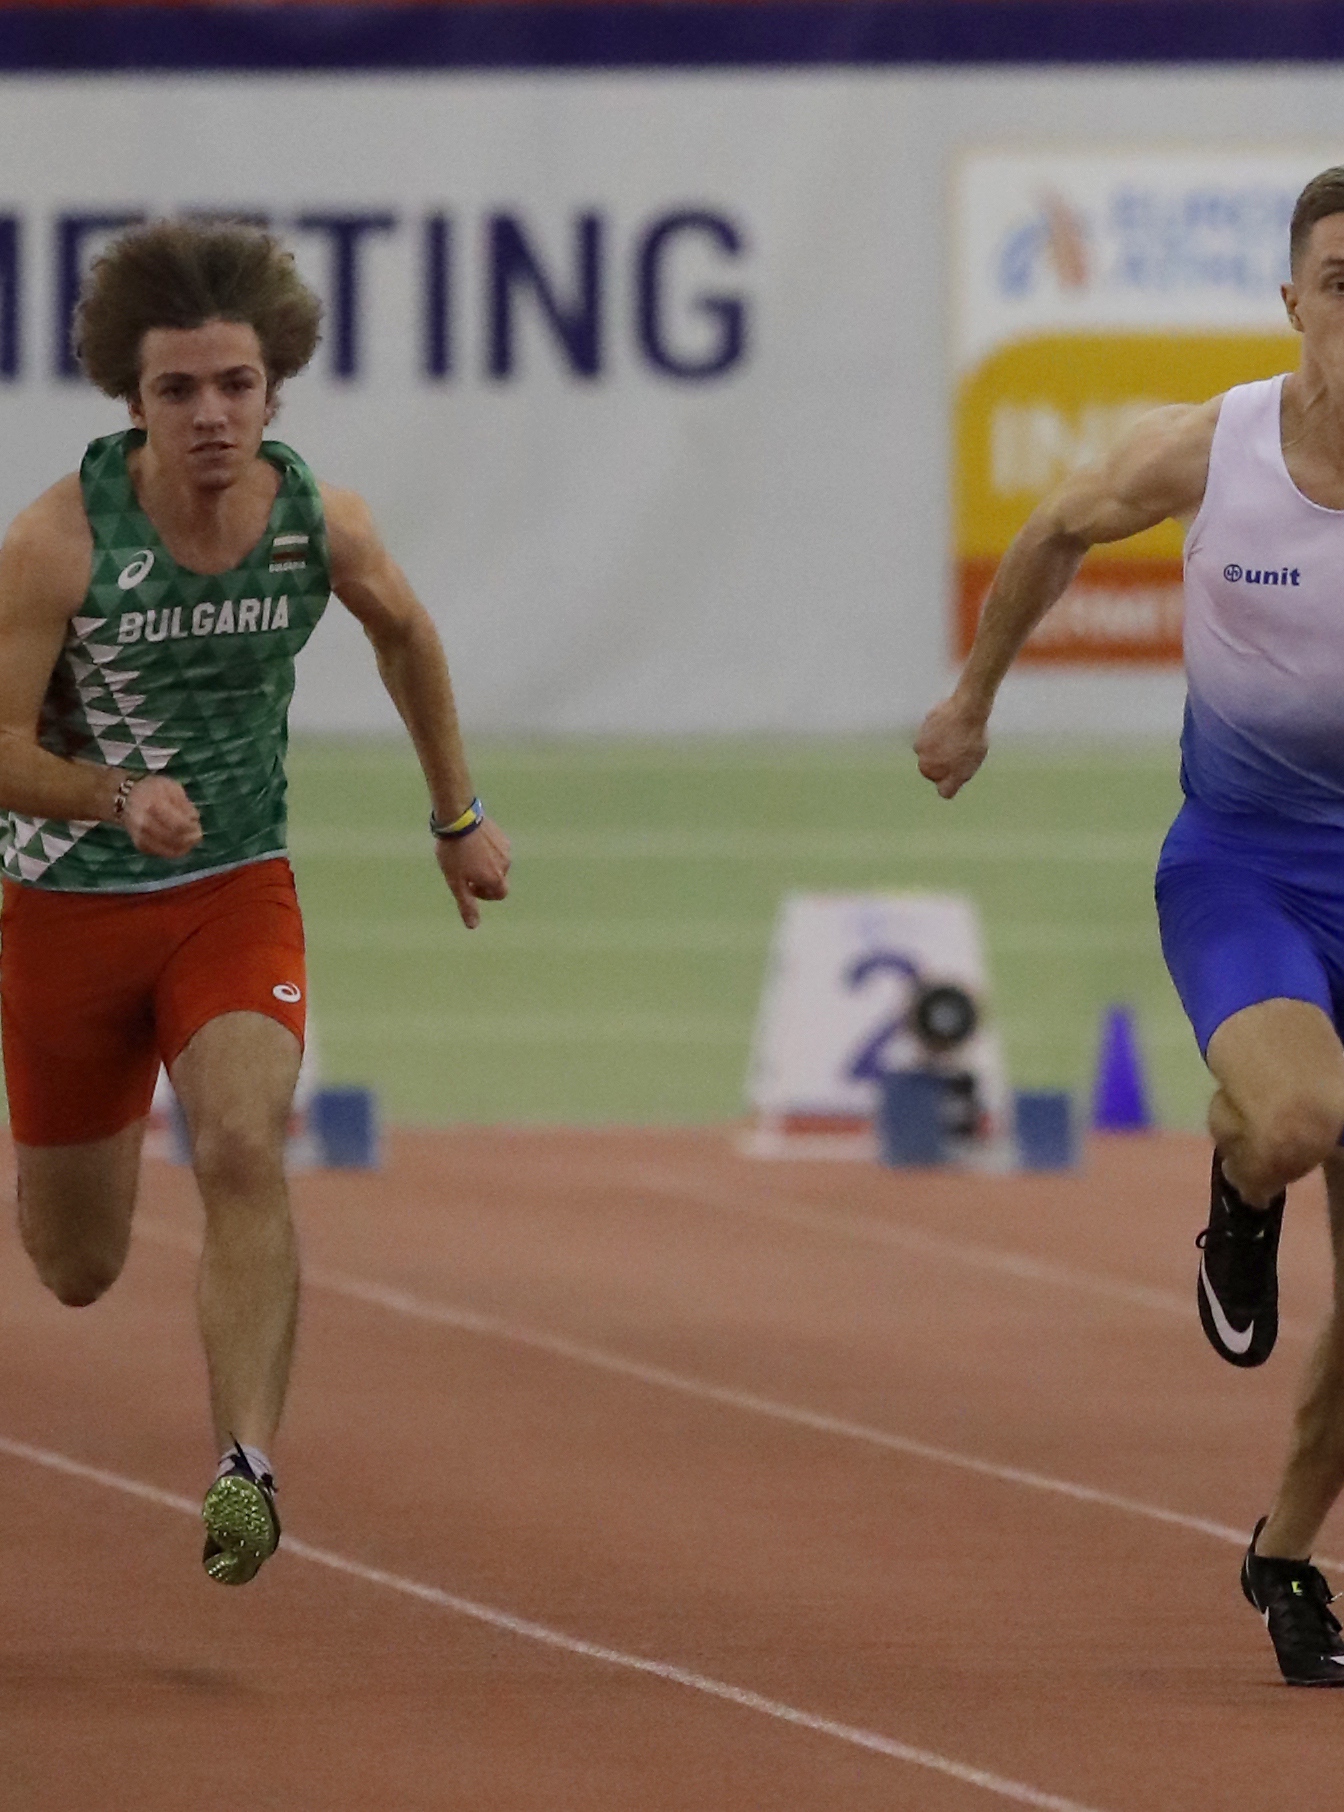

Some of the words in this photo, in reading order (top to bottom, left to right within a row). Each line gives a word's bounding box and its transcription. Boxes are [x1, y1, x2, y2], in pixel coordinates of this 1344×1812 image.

[1245, 567, 1301, 587] unit
[117, 594, 289, 644] BULGARIA
[846, 952, 921, 1082] 2
